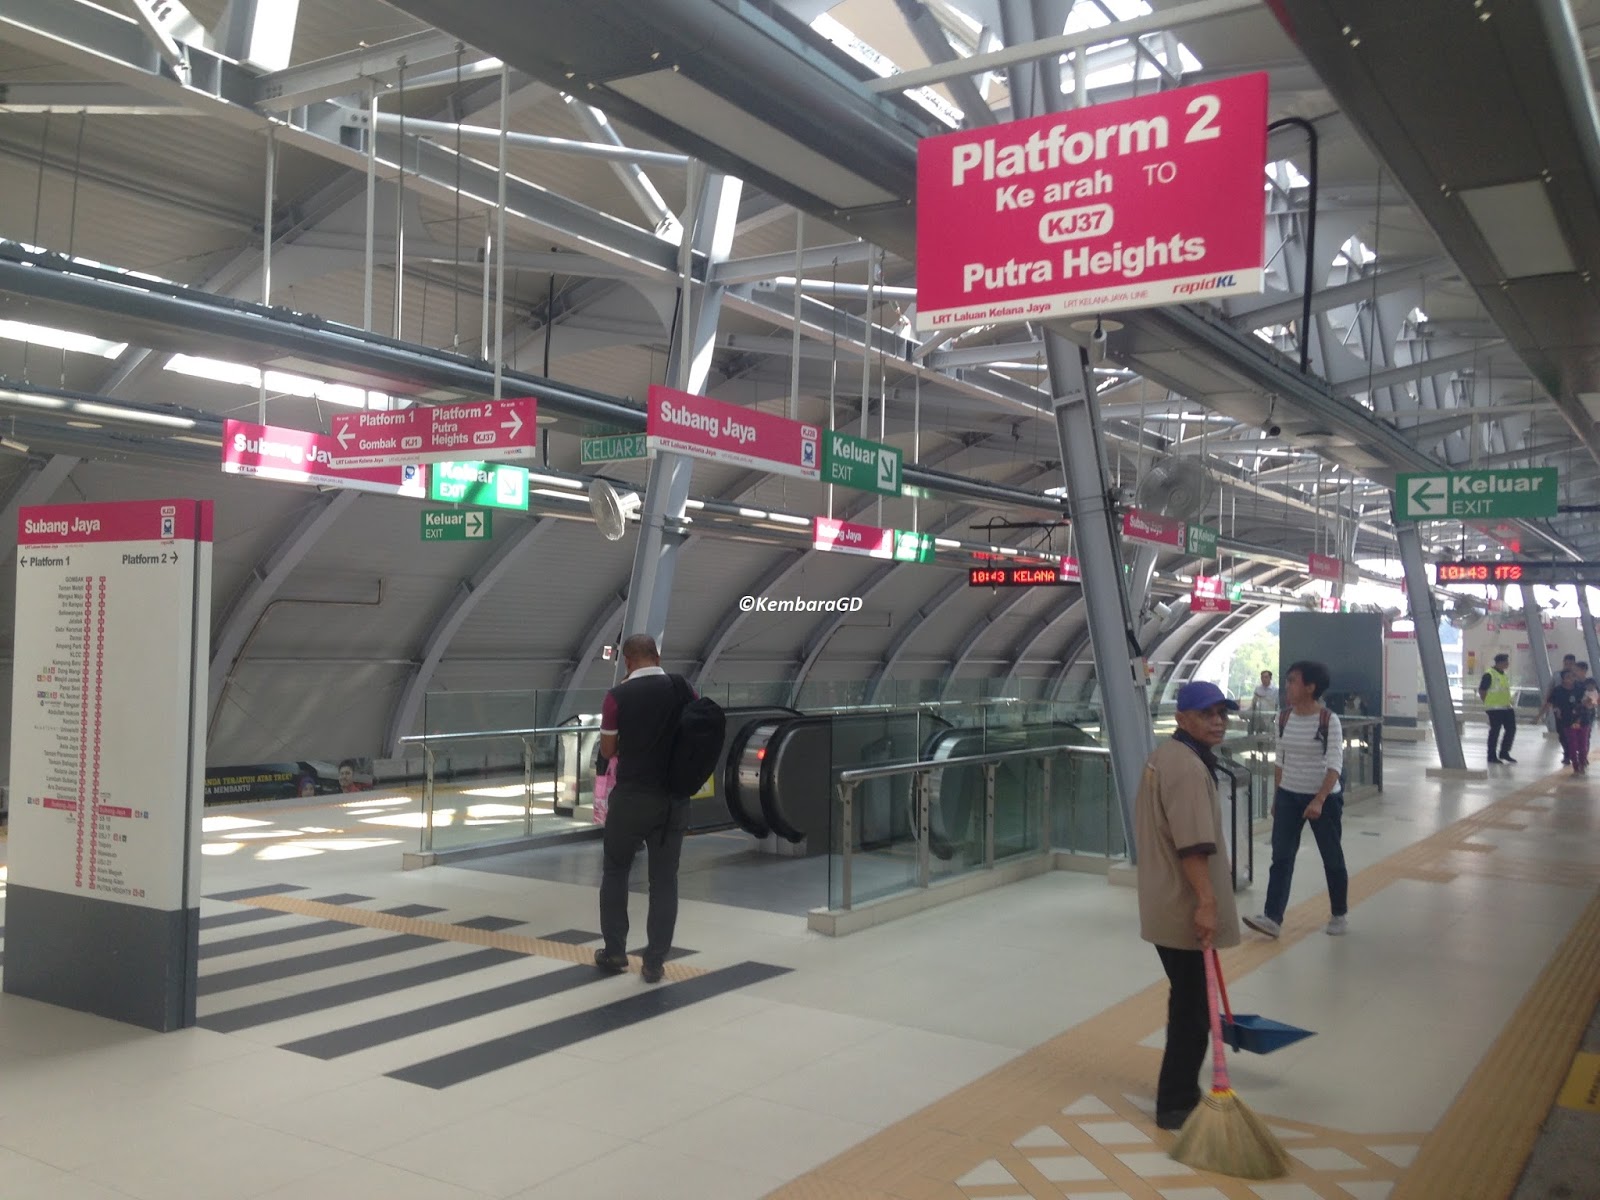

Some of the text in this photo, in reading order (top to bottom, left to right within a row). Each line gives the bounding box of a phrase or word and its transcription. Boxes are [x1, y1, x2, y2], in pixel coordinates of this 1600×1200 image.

[952, 95, 1221, 186] Platform 2
[1143, 161, 1177, 186] TO
[995, 169, 1113, 212] Ke arah
[1048, 210, 1106, 237] KJ37
[963, 233, 1206, 292] Putra Heights
[1172, 274, 1237, 295] rapidKL
[932, 302, 1051, 325] LRT Laluan Kelana Jaya
[359, 411, 415, 427] Platform 1
[432, 403, 493, 421] Platform 2
[432, 421, 458, 434] Putra
[660, 400, 757, 444] Subang Jaya
[358, 437, 397, 451] Gombak
[405, 438, 419, 447] KJ1
[431, 432, 469, 448] Heights
[475, 433, 495, 442] KJ37
[233, 432, 332, 467] Subang Jay
[583, 437, 634, 461] KELUAR
[832, 436, 877, 466] Keluar
[831, 462, 854, 481] EXIT
[1452, 474, 1545, 495] Keluar
[1452, 499, 1494, 515] EXIT
[24, 517, 101, 536] Subang Jaya
[425, 512, 464, 526] Keluar
[425, 528, 444, 539] EXIT
[845, 529, 862, 544] Jaya
[30, 556, 71, 567] Platform 1
[122, 553, 168, 566] Platform 2
[972, 570, 1055, 583] 10:43 KELANA
[1440, 565, 1488, 580] 10:43
